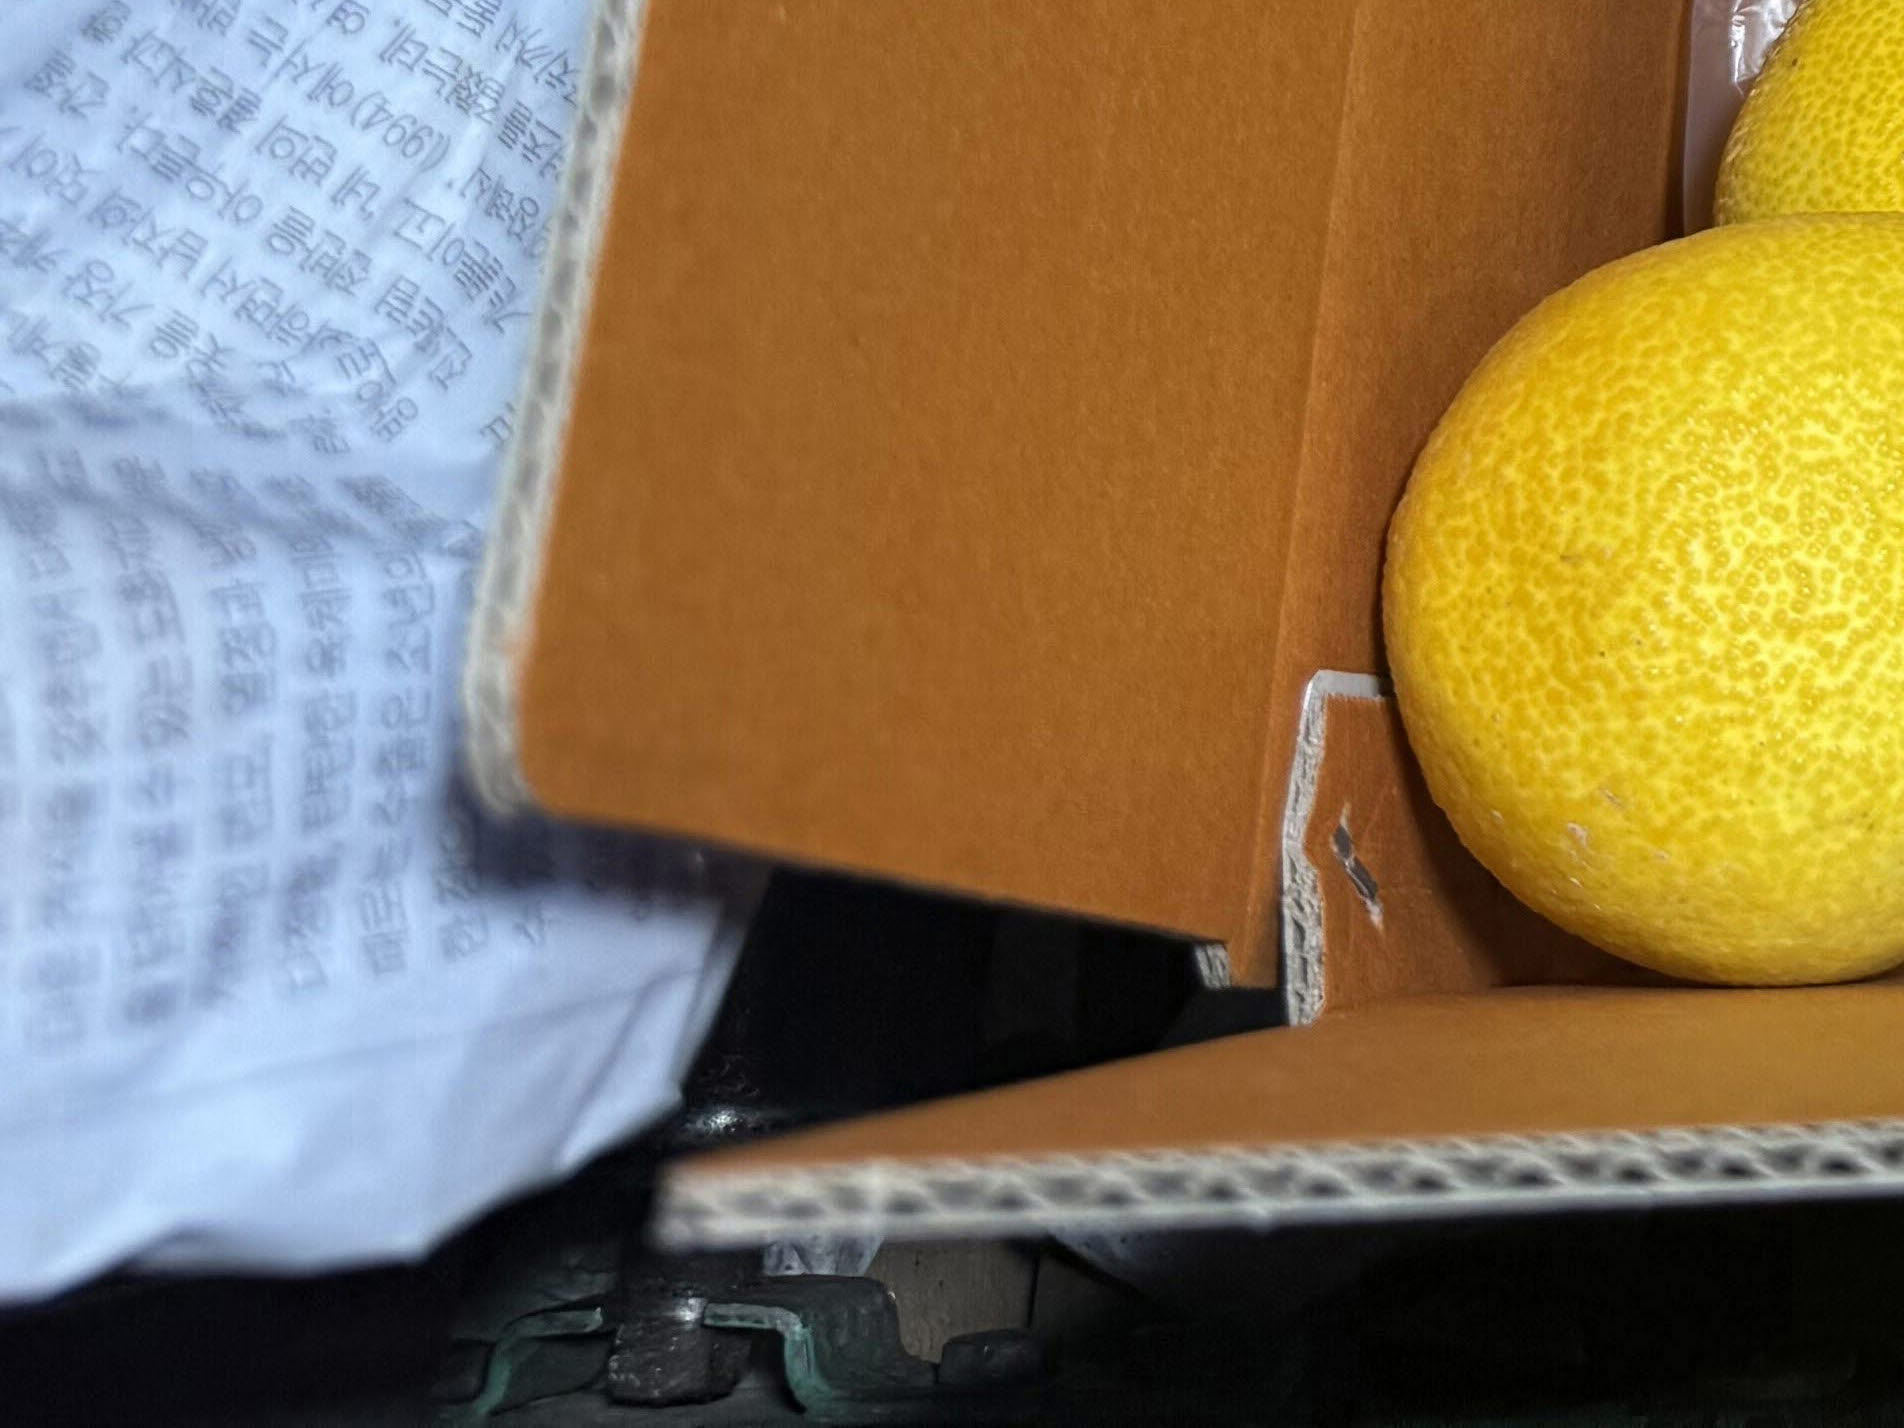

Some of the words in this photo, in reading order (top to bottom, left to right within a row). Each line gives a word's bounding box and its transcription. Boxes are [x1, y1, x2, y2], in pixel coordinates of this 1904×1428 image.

[253, 115, 336, 186] 번의
[262, 207, 370, 296] 전반을
[60, 259, 152, 330] 가장
